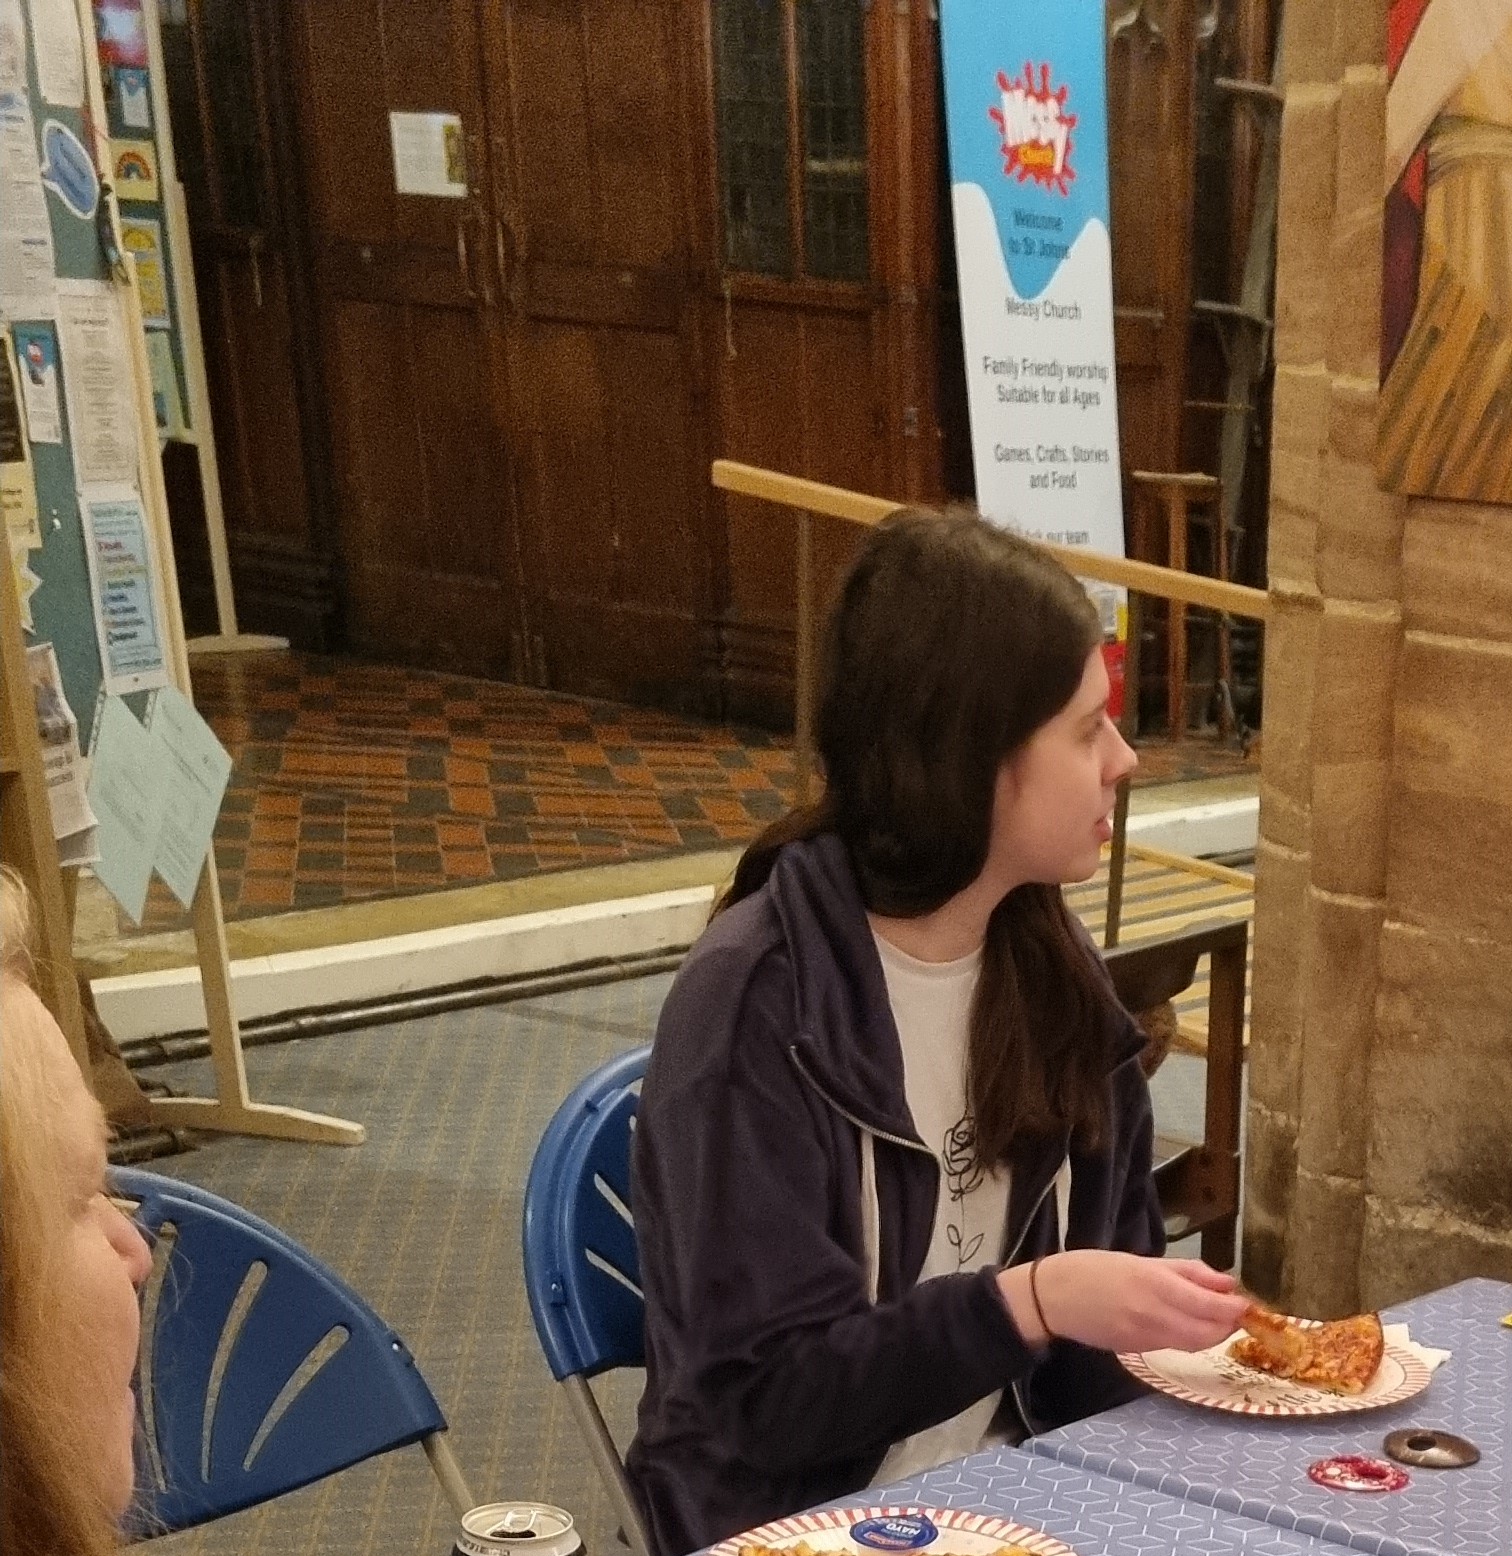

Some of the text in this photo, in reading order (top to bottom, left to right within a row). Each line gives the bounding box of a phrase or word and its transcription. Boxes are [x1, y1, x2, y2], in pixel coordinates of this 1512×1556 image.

[1012, 208, 1064, 231] Welcome
[1006, 297, 1082, 321] Messy Church
[982, 355, 1109, 384] Family Friendly worship
[997, 383, 1039, 404] Suitable
[1042, 384, 1056, 404] for
[1073, 387, 1101, 411] Ages
[1072, 445, 1110, 463] Stories
[1029, 470, 1078, 489] and Food
